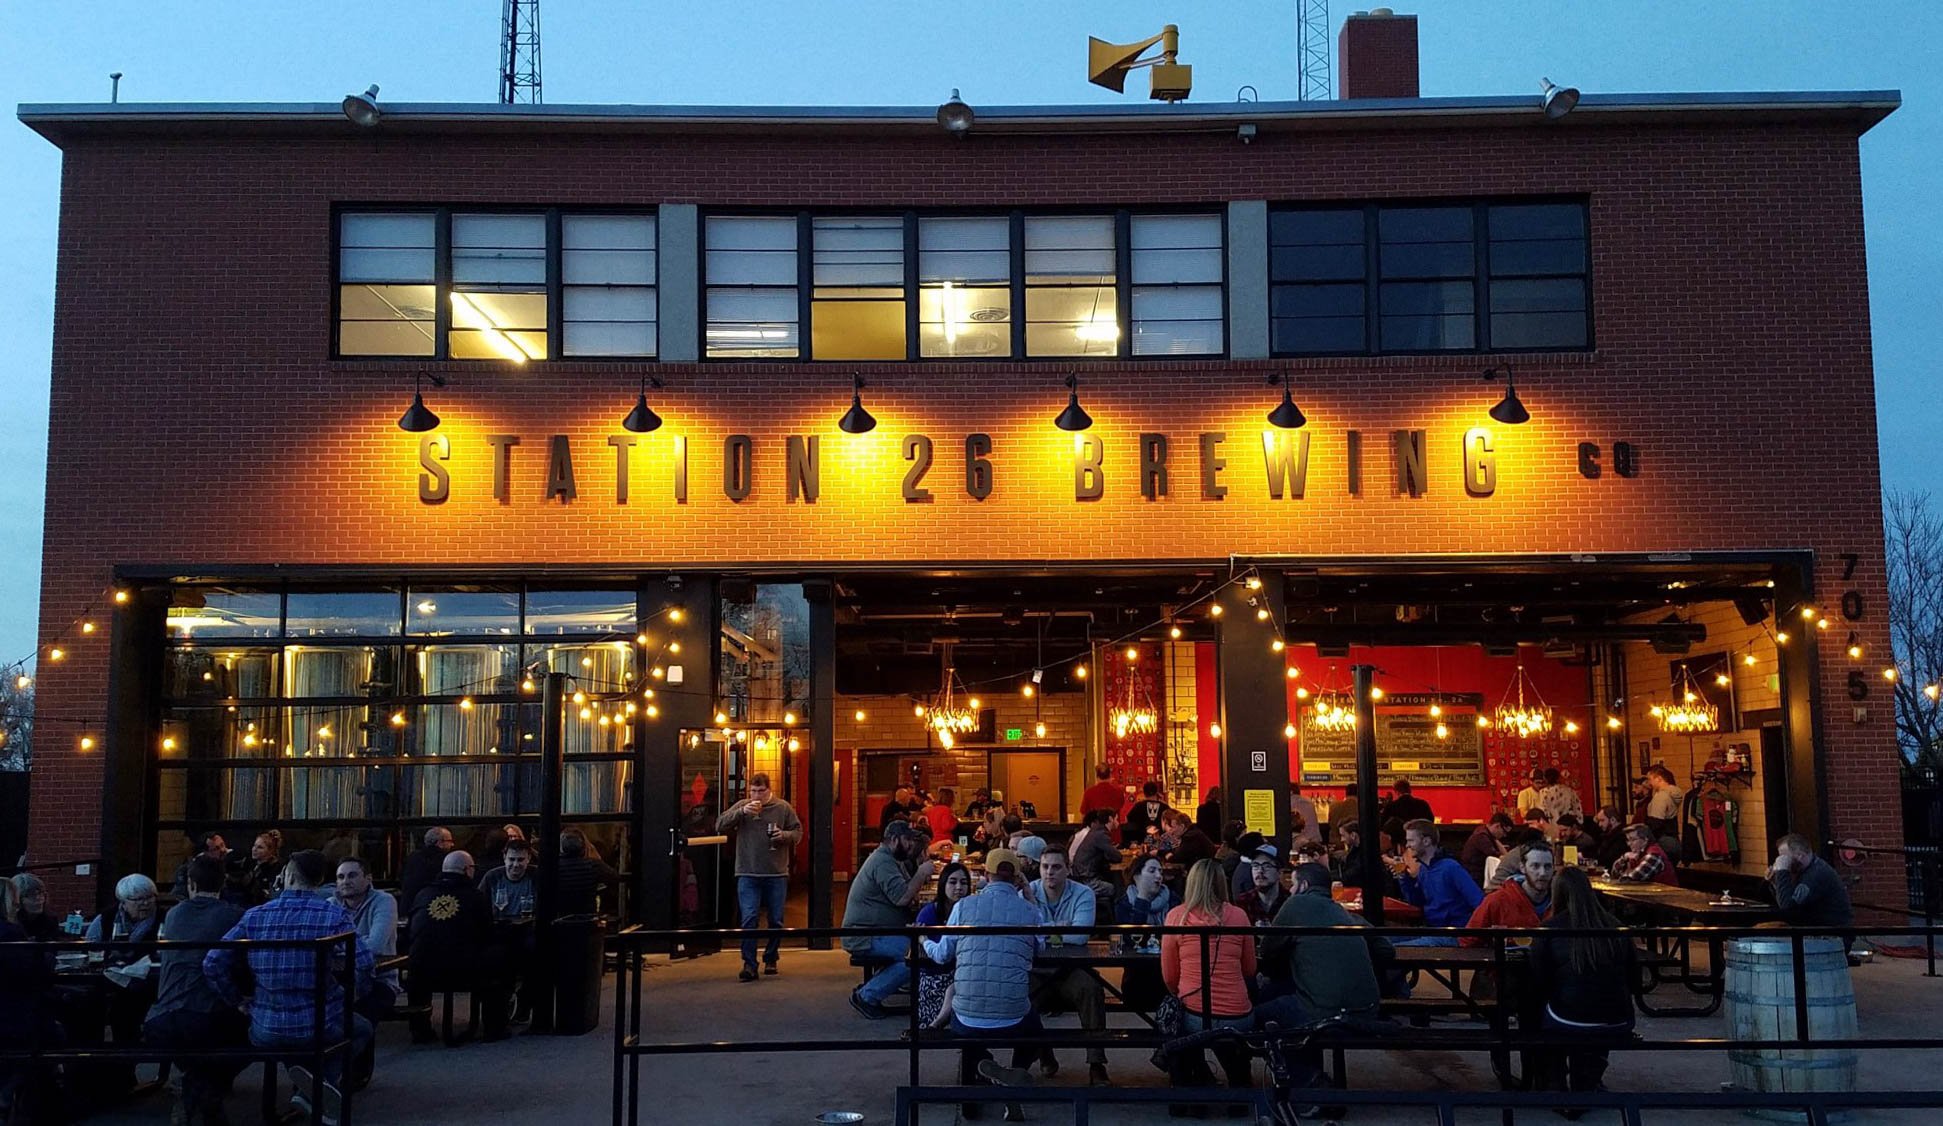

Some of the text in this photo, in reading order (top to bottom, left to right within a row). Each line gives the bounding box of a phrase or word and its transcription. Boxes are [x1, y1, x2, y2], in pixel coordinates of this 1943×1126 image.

[419, 434, 819, 502] STATION
[902, 433, 993, 501] 26
[1074, 428, 1496, 501] BREWING
